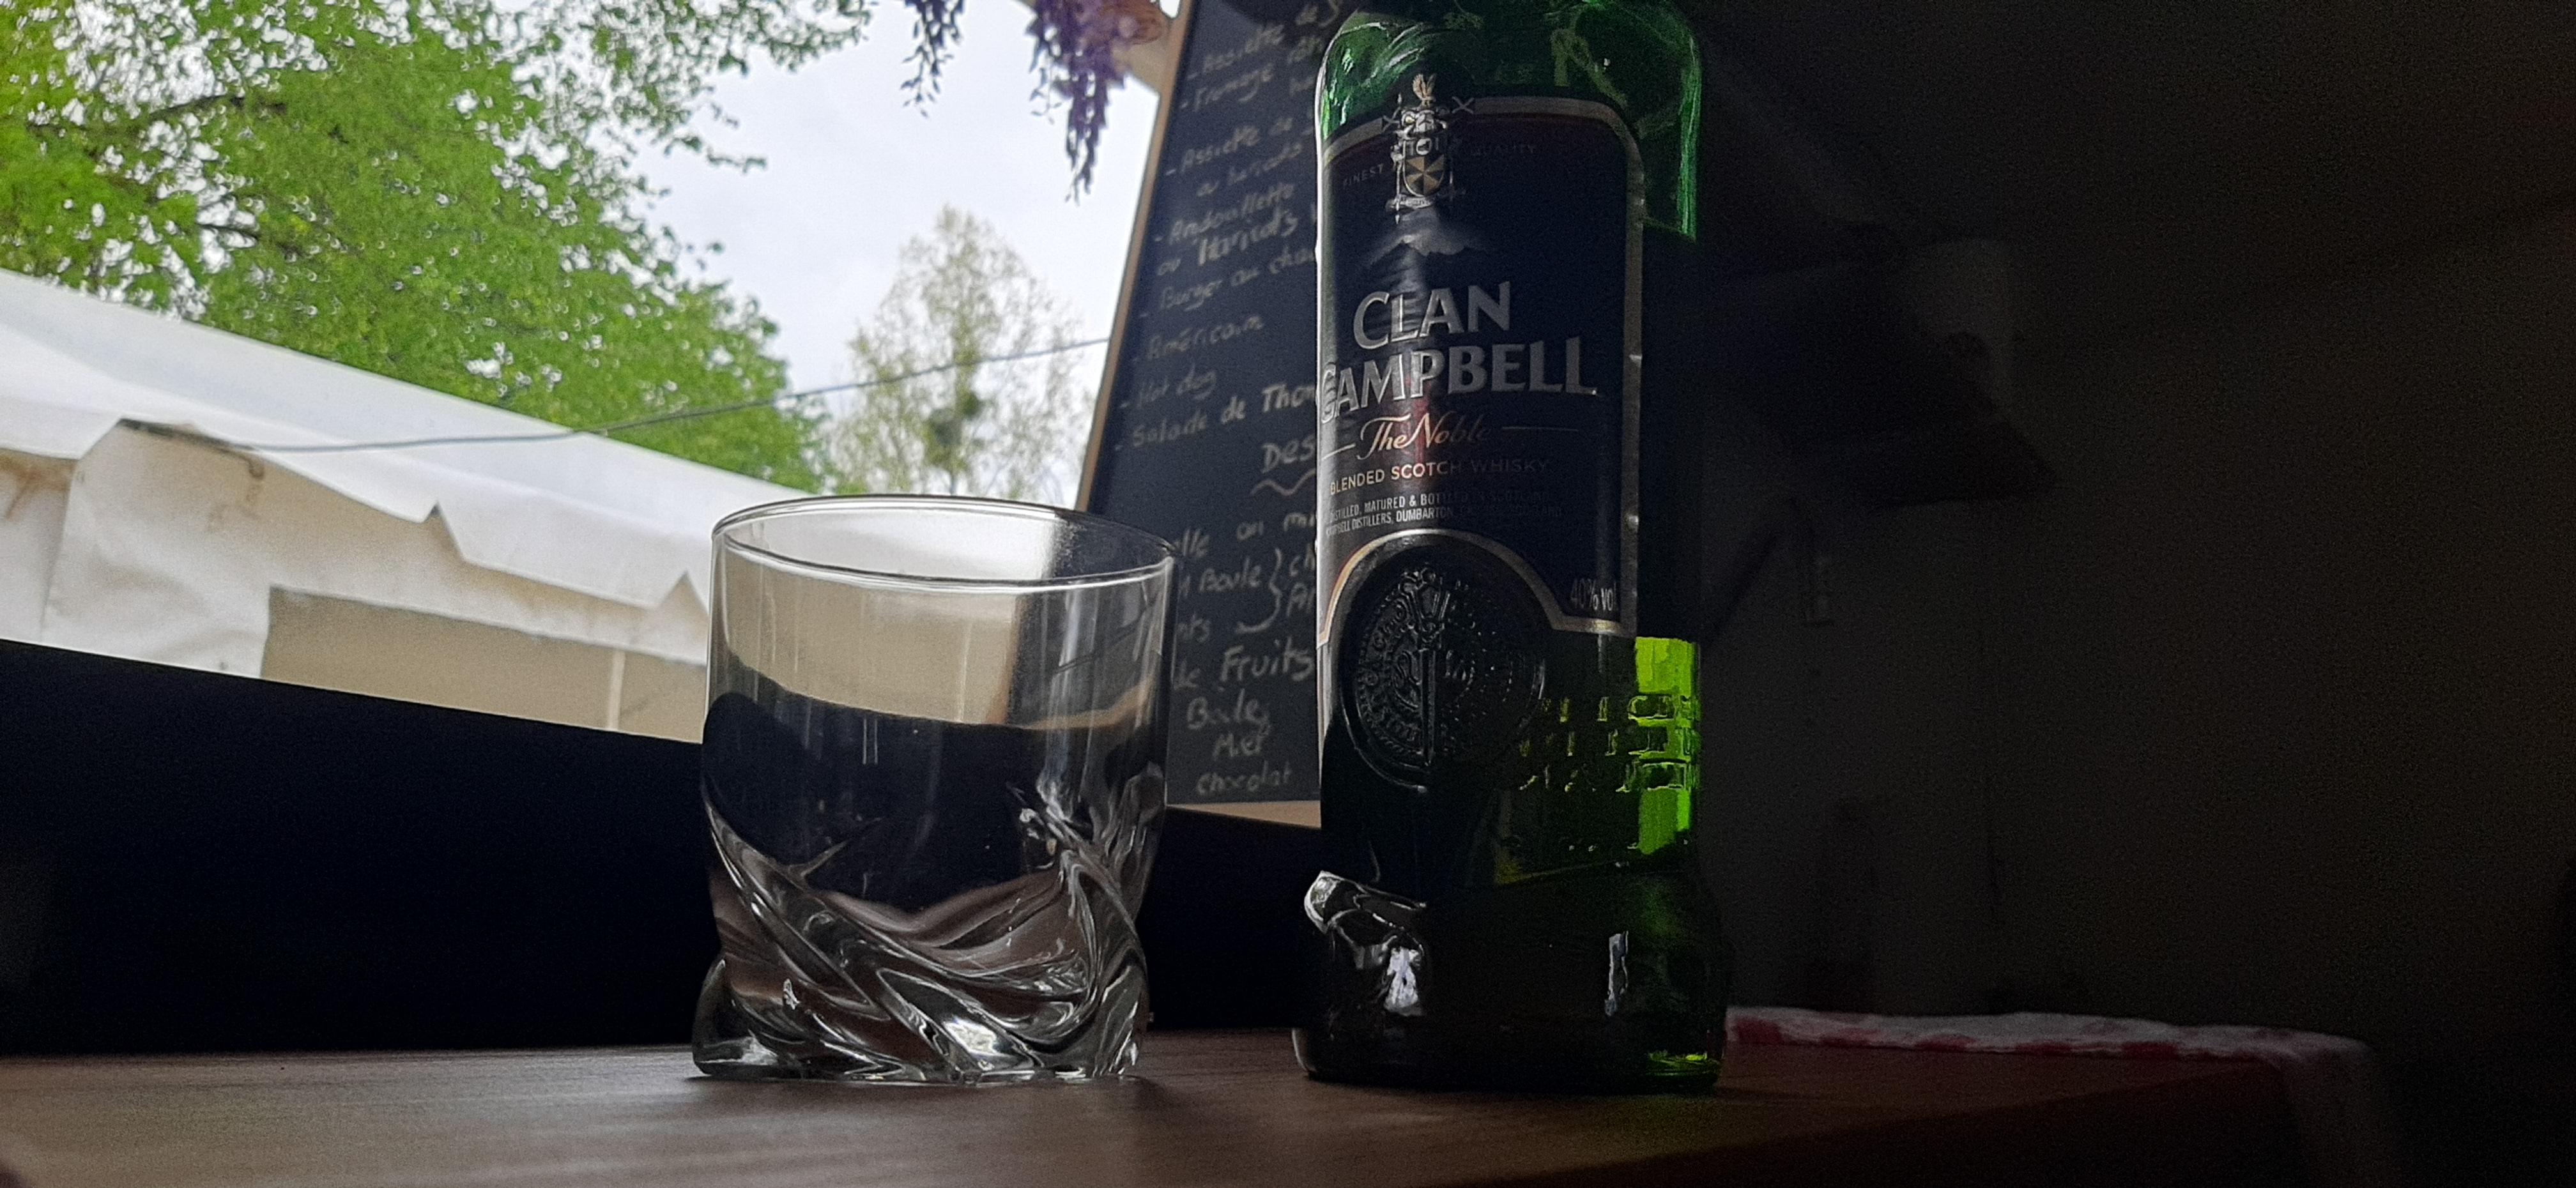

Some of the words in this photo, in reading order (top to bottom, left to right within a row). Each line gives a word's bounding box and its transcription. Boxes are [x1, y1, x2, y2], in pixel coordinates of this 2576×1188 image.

[1353, 280, 1511, 350] CLAN
[1320, 337, 1598, 423] CAMPBELL
[1330, 469, 1385, 496] BLENDED
[1391, 460, 1462, 480] SCOTCH
[1471, 458, 1549, 474] WHISKY
[1409, 494, 1417, 507] &
[1220, 636, 1314, 682] Fruits
